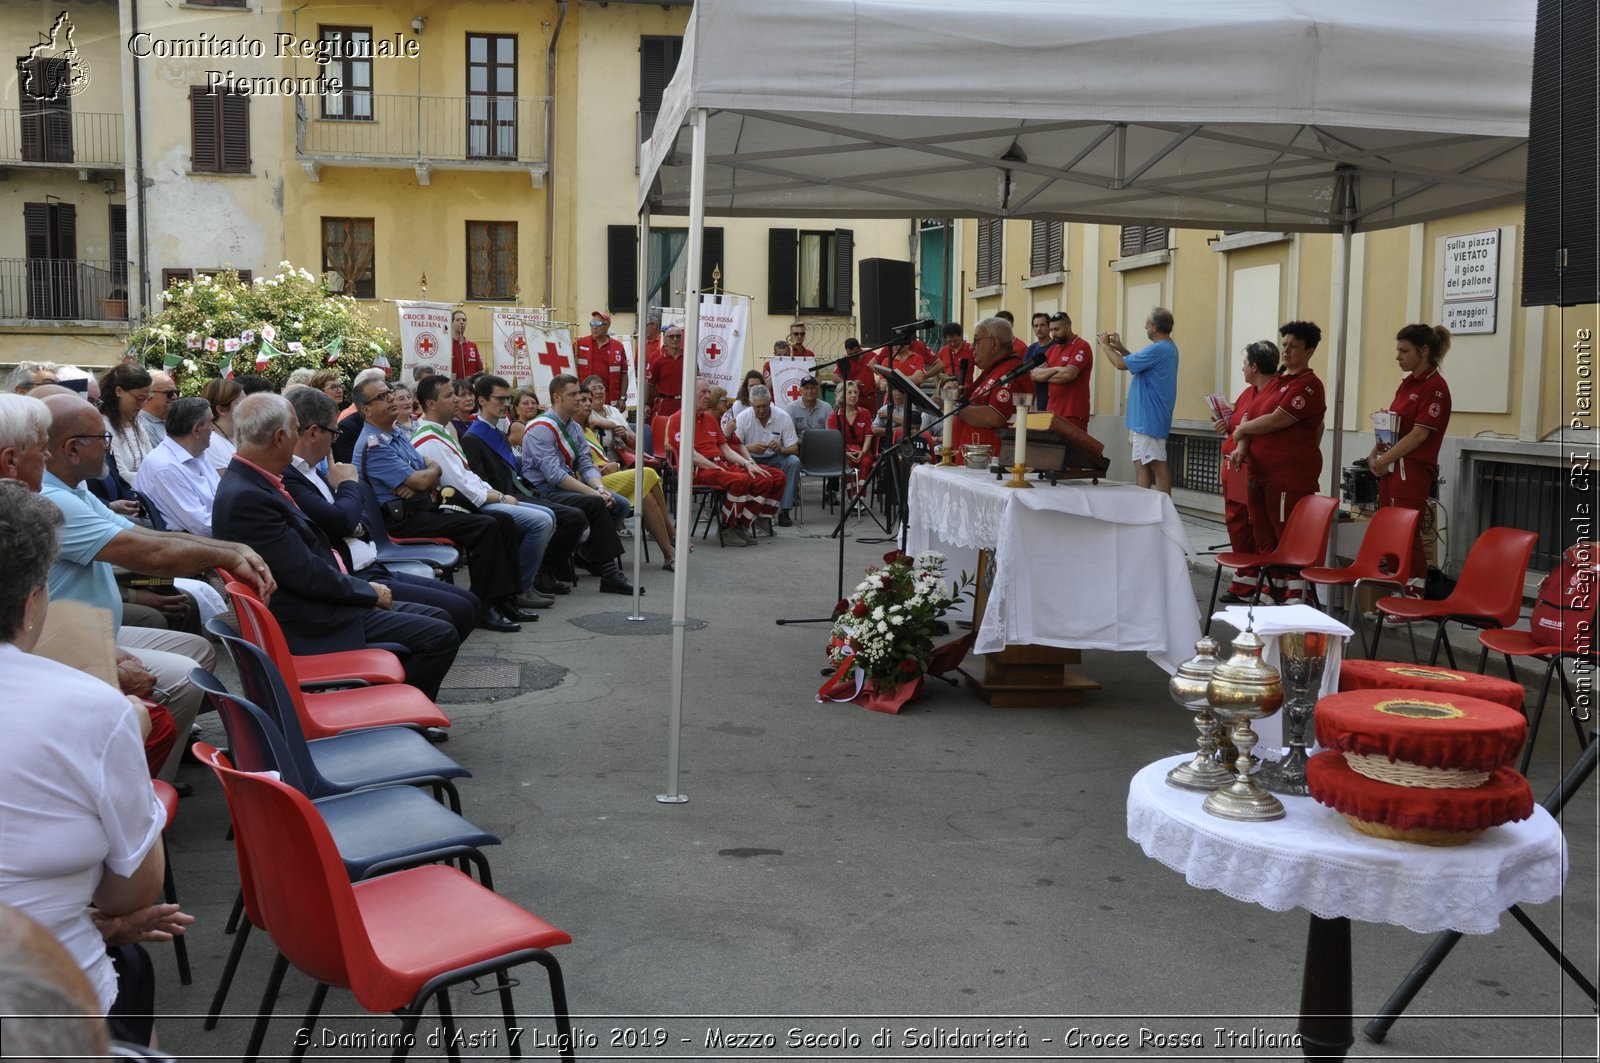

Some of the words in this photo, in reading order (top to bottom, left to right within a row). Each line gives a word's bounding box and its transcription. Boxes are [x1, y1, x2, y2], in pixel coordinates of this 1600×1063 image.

[1447, 240, 1466, 250] sulla
[1468, 237, 1496, 250] piazza
[1453, 249, 1488, 262] VIETATO
[1454, 265, 1460, 275] il
[1462, 264, 1485, 276] gioco
[1447, 278, 1460, 288] del
[1461, 276, 1492, 289] pallone
[428, 314, 448, 322] ROSSA
[1448, 309, 1455, 317] ai
[1456, 306, 1488, 318] maggiori
[1450, 320, 1457, 328] di
[1459, 319, 1467, 328] 12
[1469, 319, 1484, 328] anni
